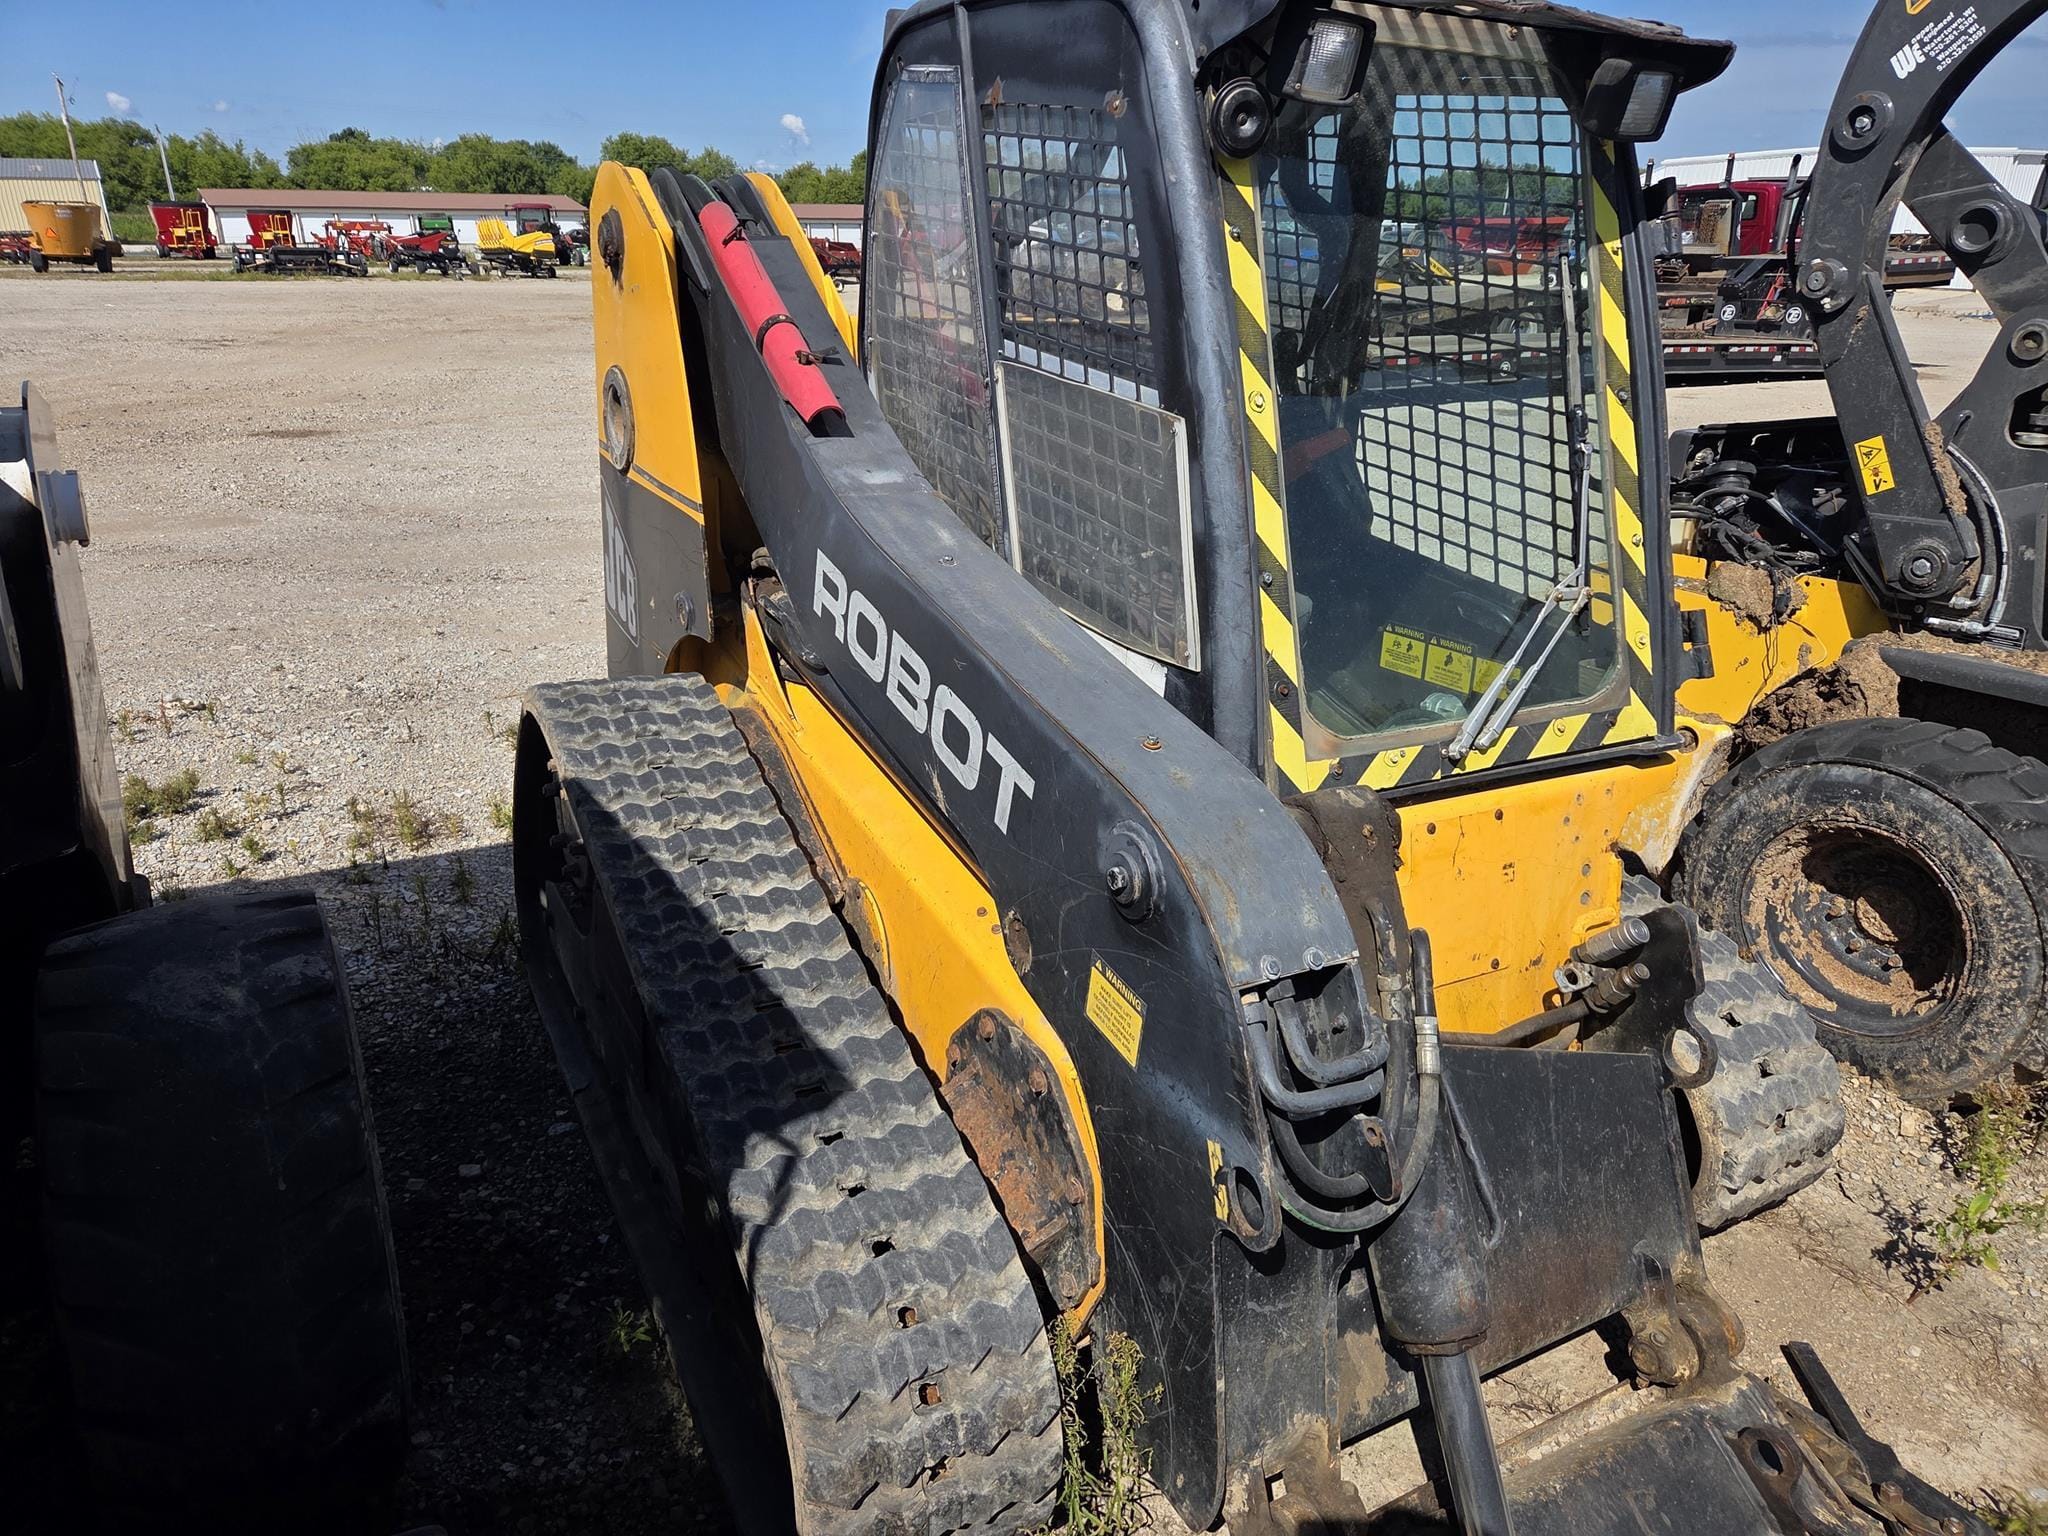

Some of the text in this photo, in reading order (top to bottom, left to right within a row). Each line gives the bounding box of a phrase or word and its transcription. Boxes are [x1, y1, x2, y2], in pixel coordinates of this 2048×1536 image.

[1923, 6, 1975, 53] Watertown, WI
[1929, 13, 1978, 57] 920-261-5301
[1936, 23, 1979, 61] Waupun, WI
[1936, 26, 1986, 72] 920-324-3597
[1395, 626, 1425, 640] WARNING
[1440, 639, 1472, 654] WARNING
[813, 548, 1035, 836] ROBOT
[1105, 967, 1142, 1012] WARNING
